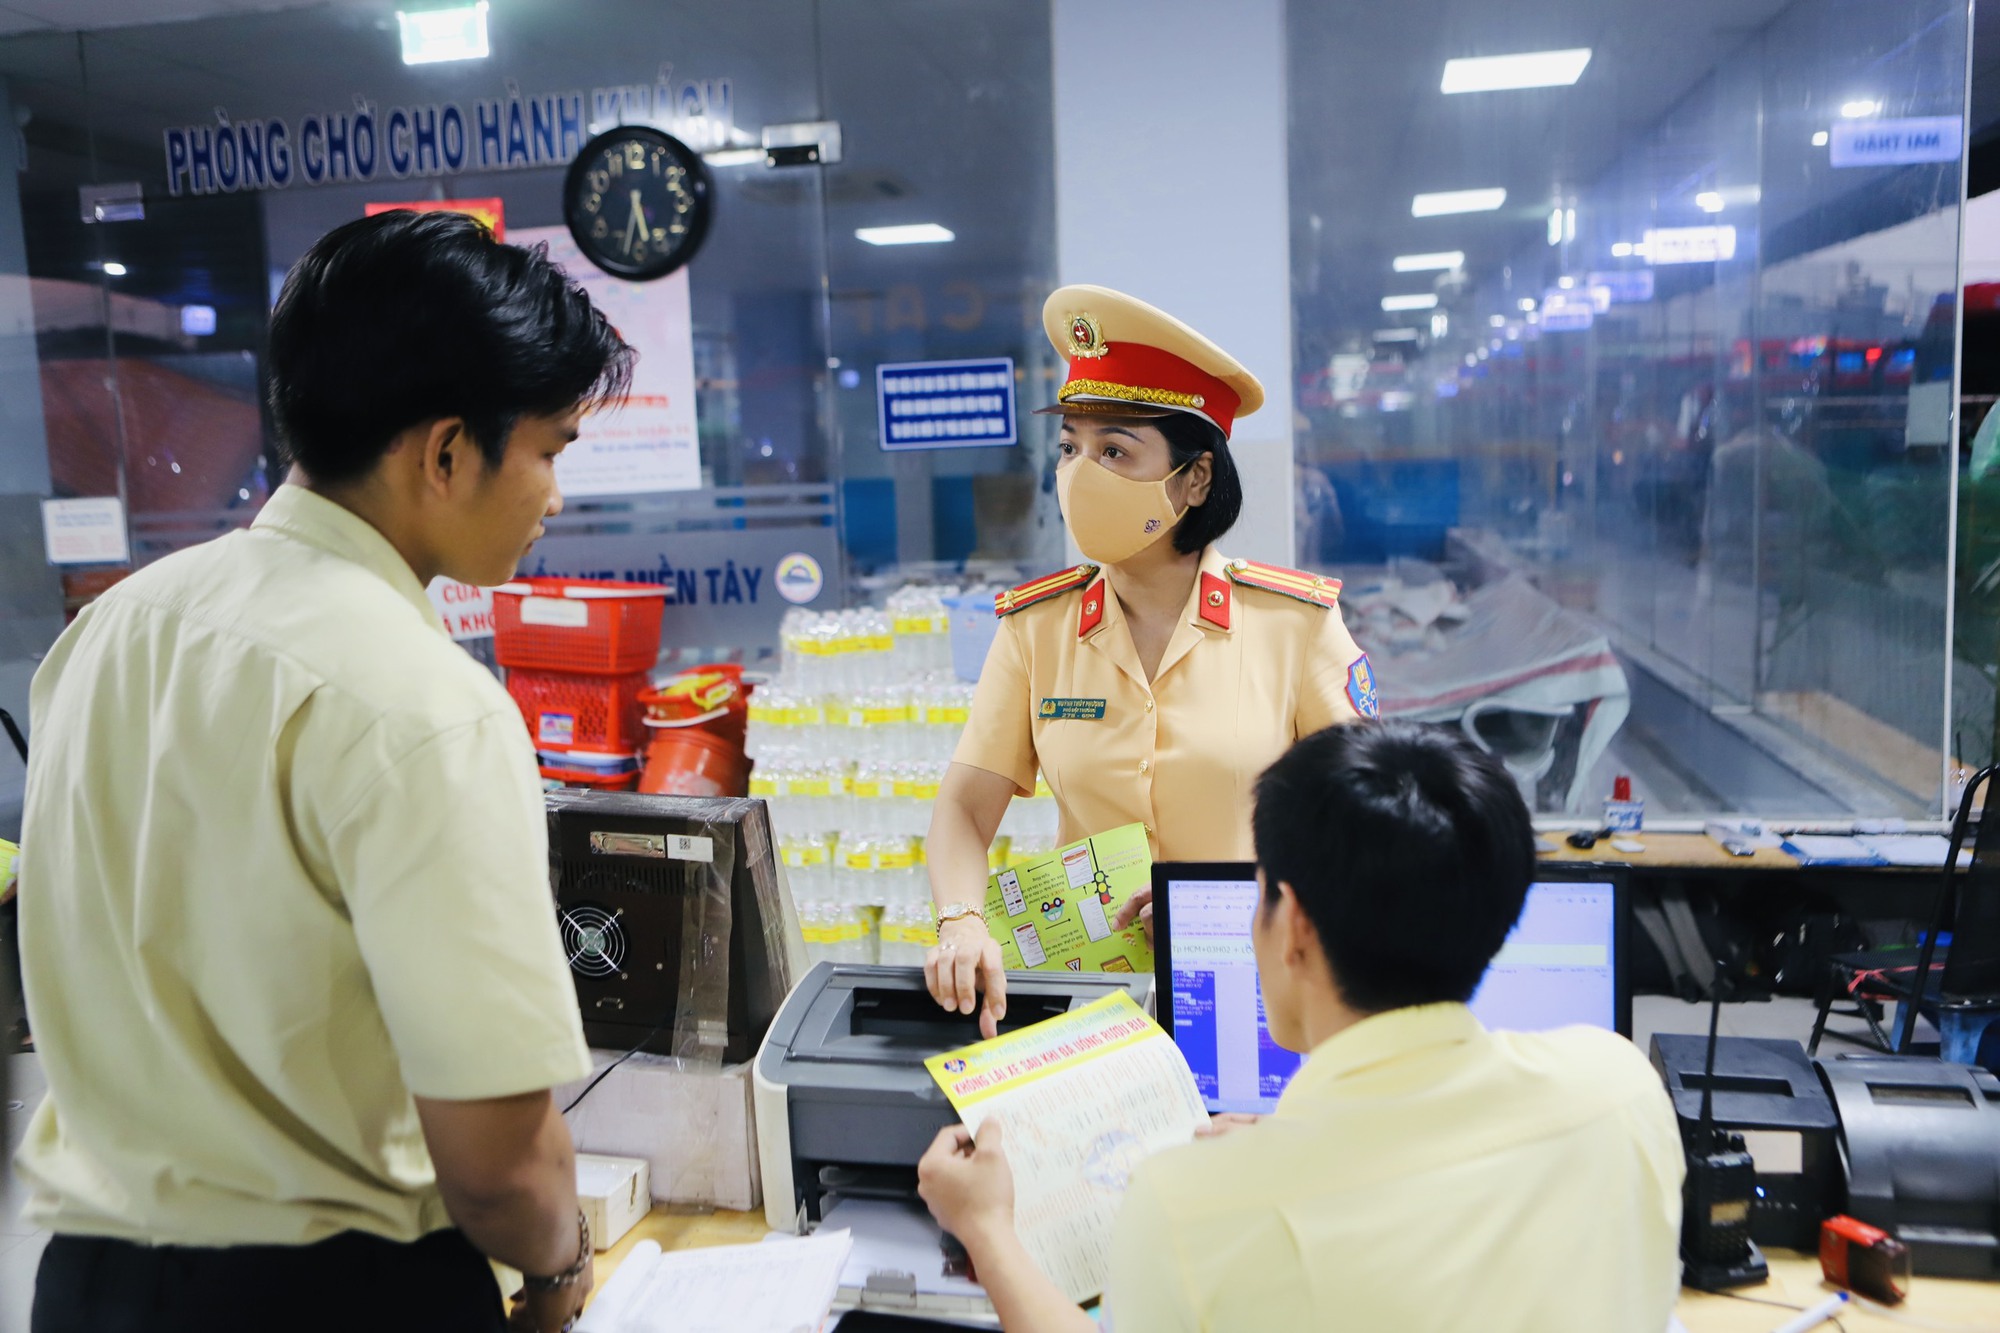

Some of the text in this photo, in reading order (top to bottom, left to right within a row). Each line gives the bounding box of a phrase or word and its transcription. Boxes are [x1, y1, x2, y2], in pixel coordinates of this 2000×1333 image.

[164, 106, 293, 197] PHÒNG
[298, 94, 380, 186] CHỜ
[384, 102, 469, 180] CHO
[473, 76, 586, 170] HÀNH
[953, 1075, 990, 1096] KHÔNG
[1040, 1048, 1061, 1064] KHI
[1126, 1017, 1148, 1032] BIA
